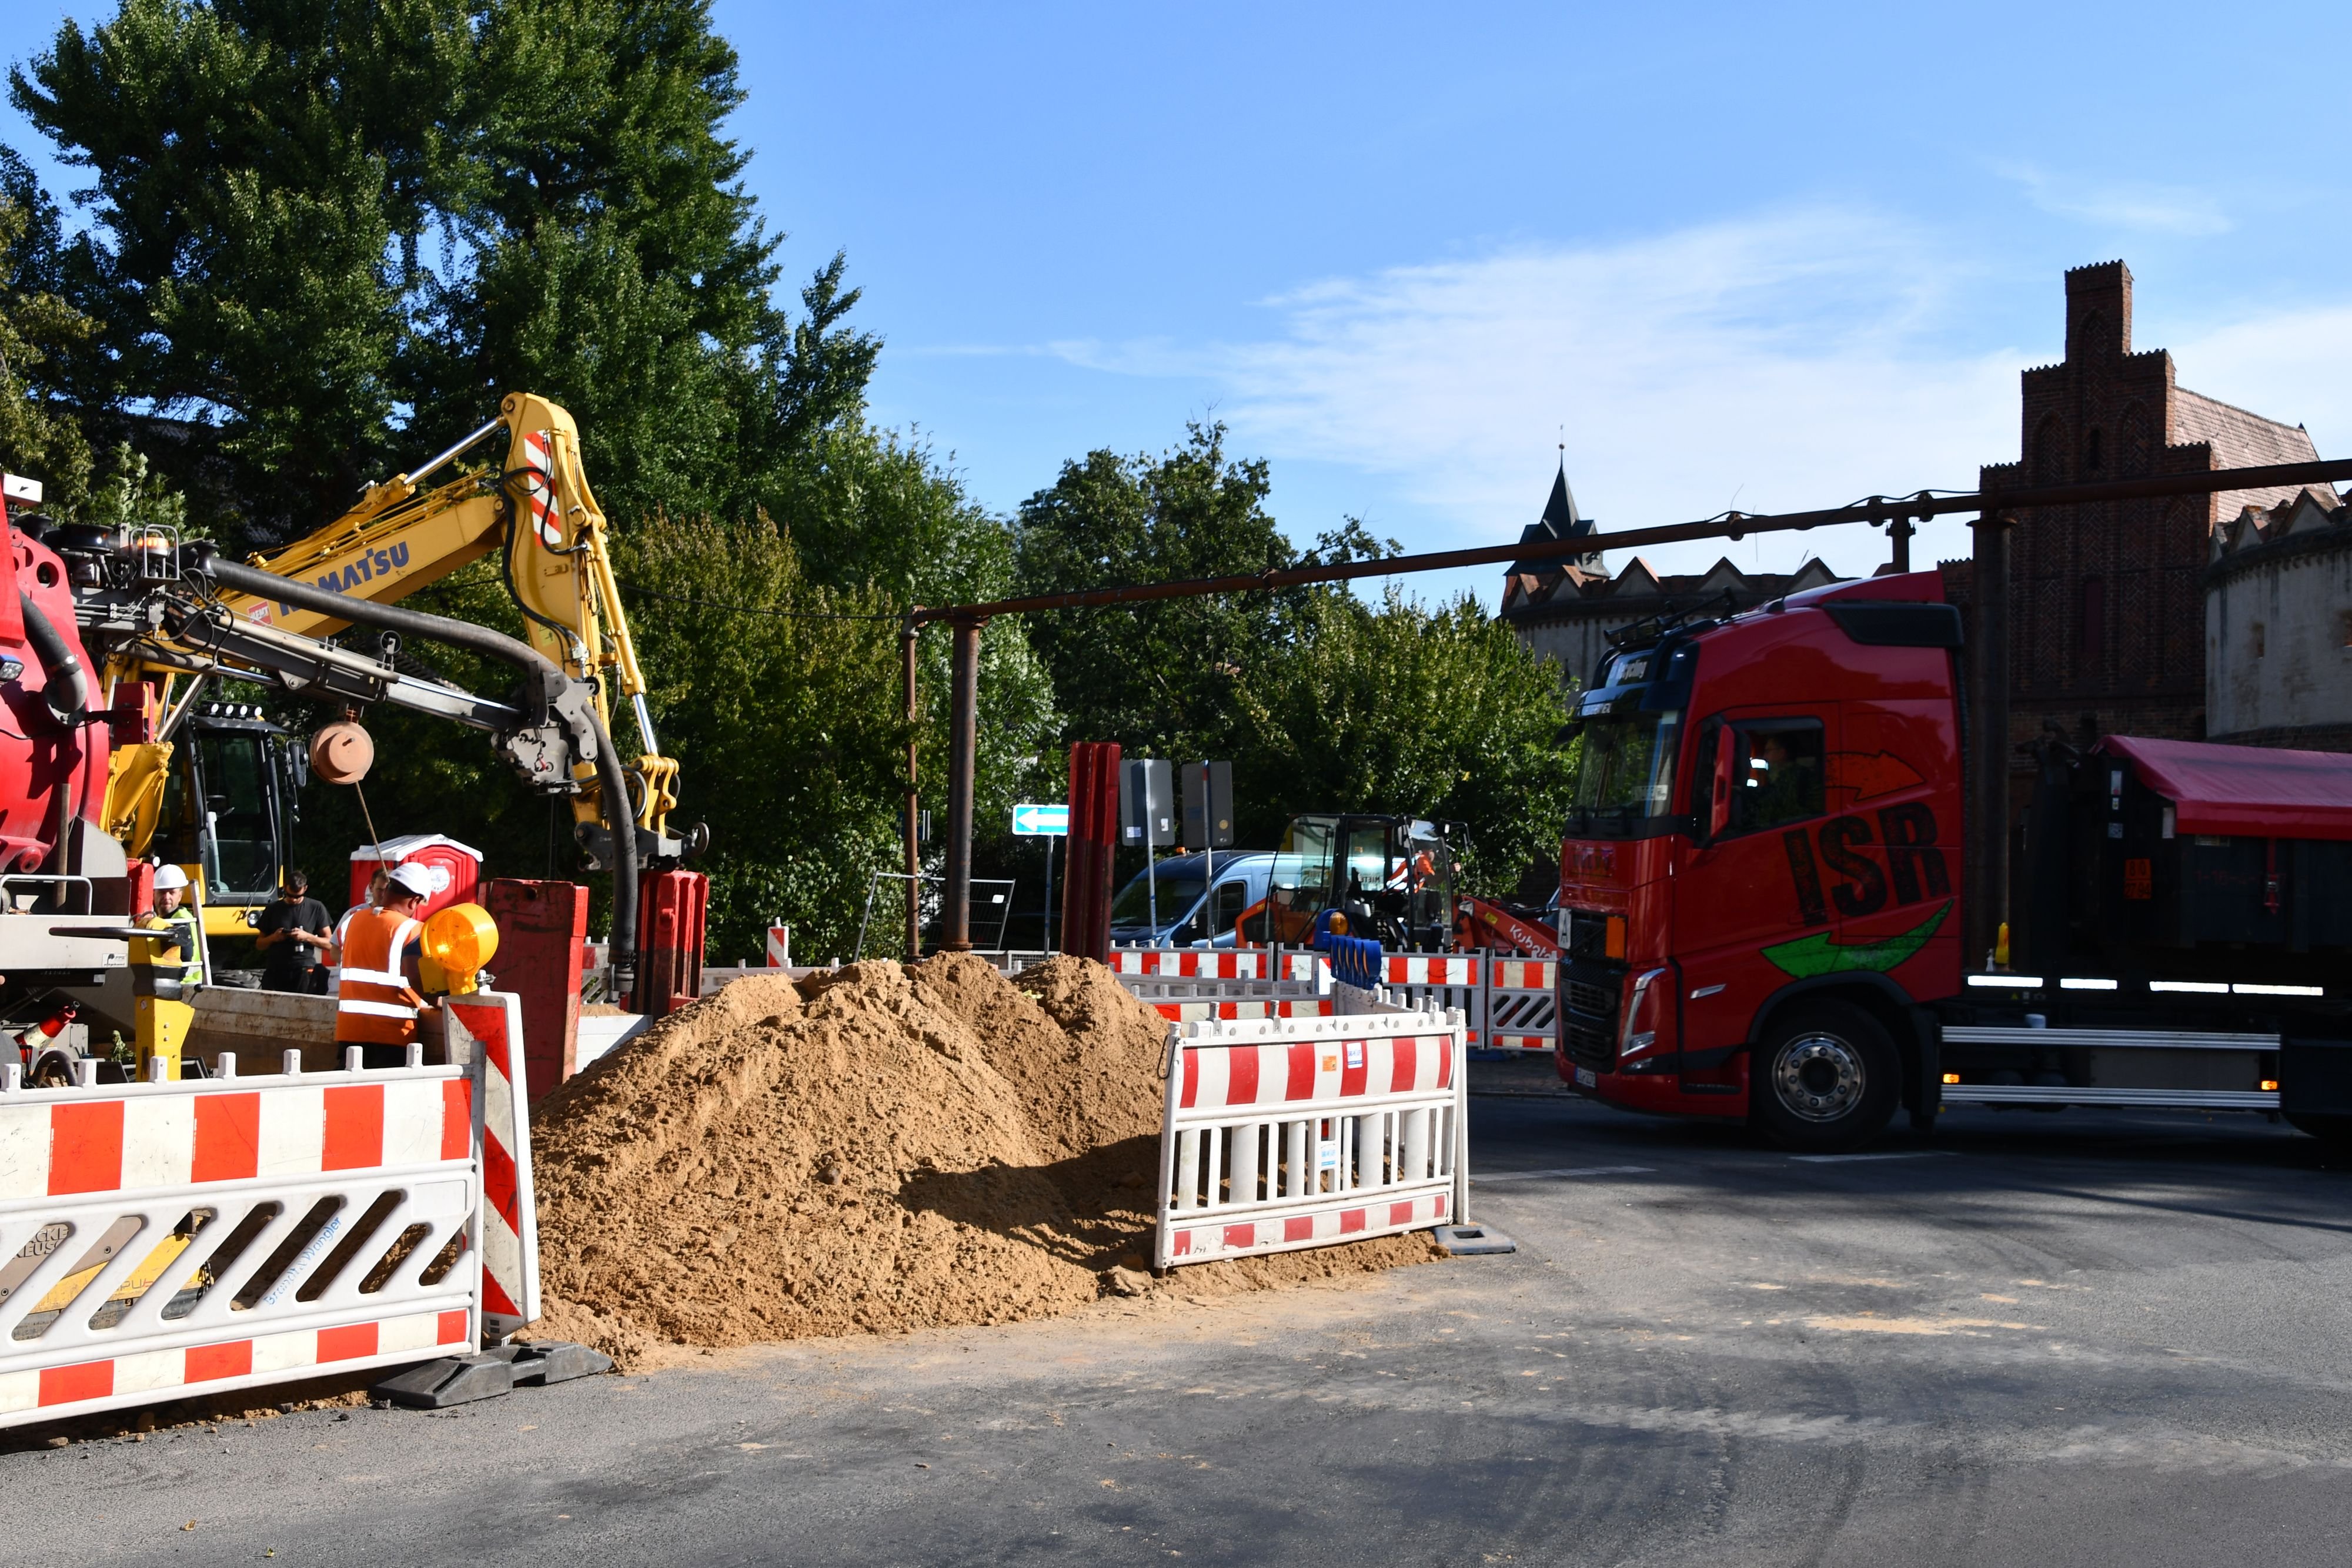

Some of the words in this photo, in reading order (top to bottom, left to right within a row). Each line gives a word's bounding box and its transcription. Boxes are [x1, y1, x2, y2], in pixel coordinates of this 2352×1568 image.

[279, 541, 410, 616] MATSU
[1782, 801, 1950, 927] ISR
[1561, 922, 1568, 944] A
[264, 1268, 299, 1305] Brandt
[302, 1217, 342, 1261] Wangler
